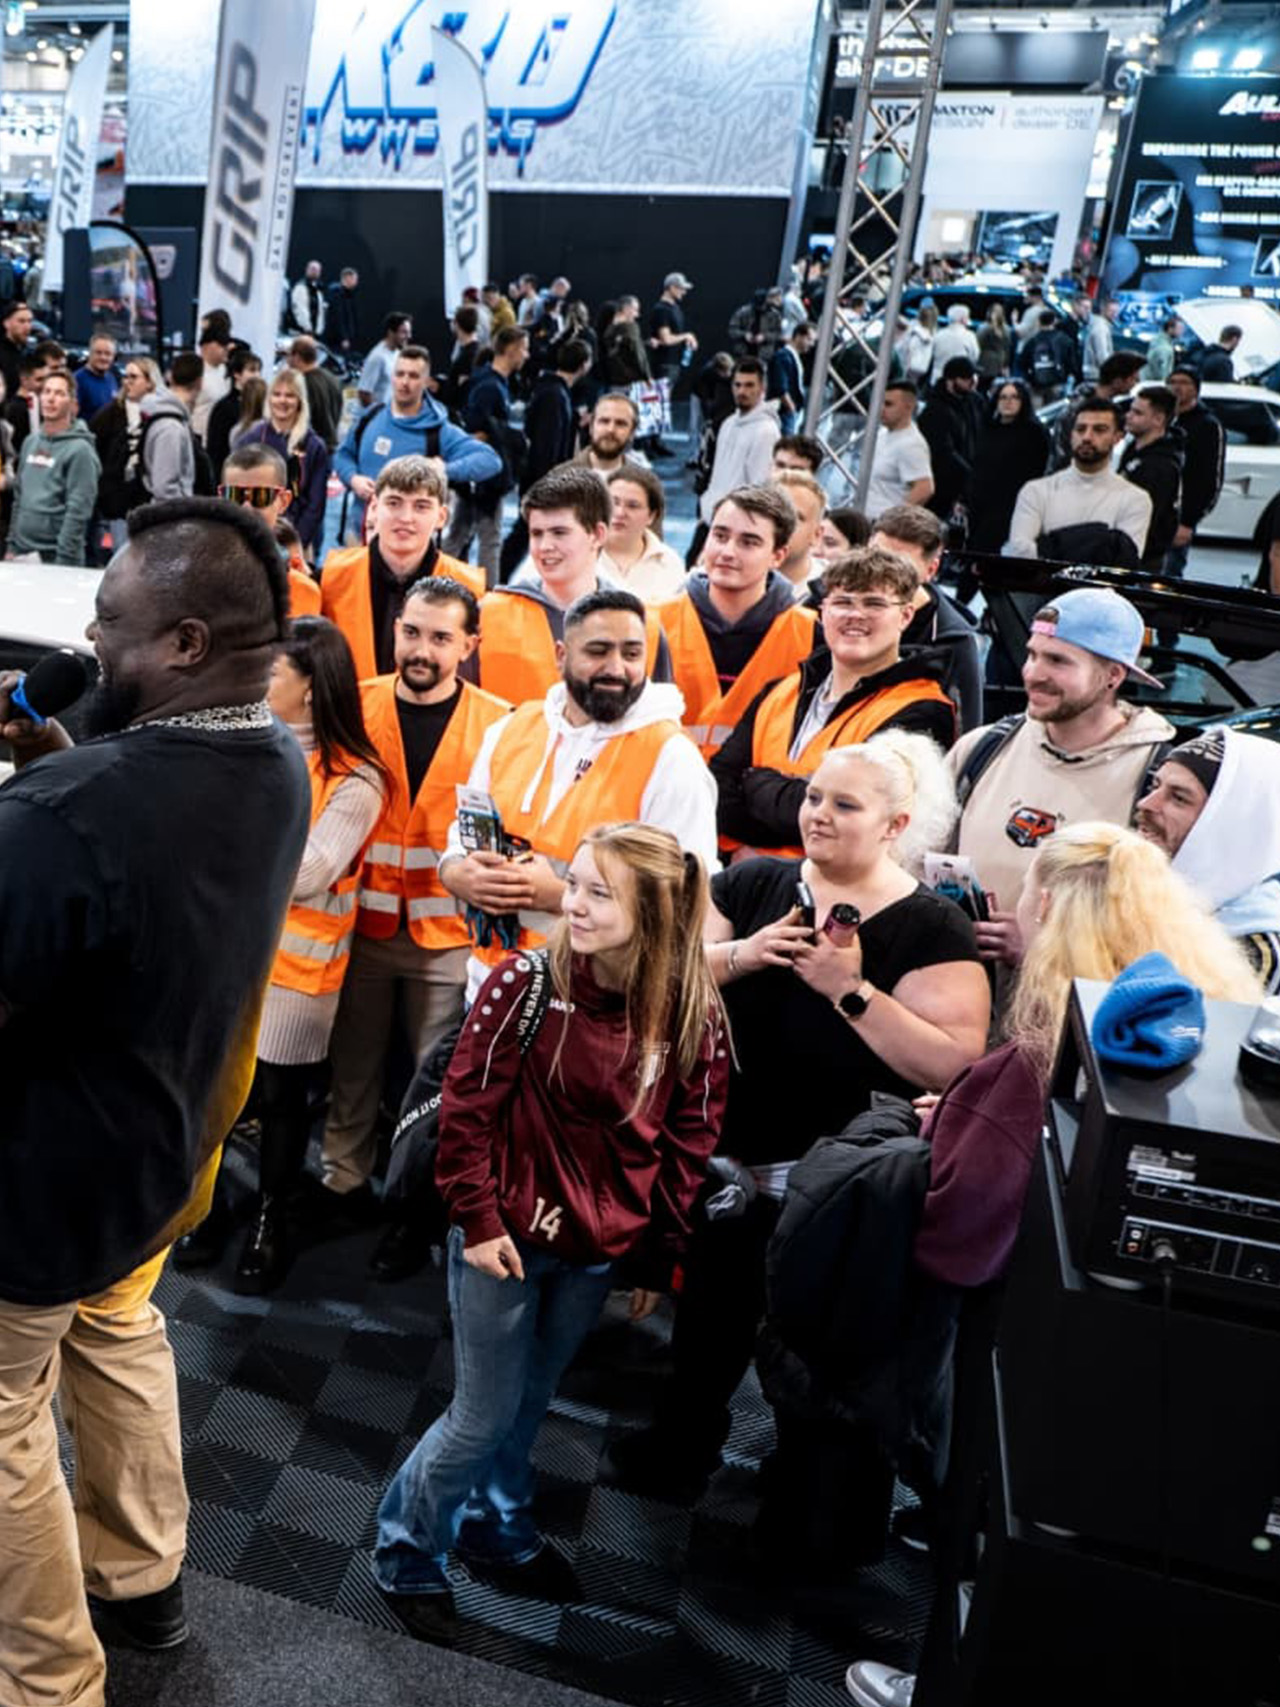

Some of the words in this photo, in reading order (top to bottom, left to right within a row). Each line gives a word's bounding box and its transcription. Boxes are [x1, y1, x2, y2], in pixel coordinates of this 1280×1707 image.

[341, 117, 536, 146] WHES
[210, 39, 268, 306] GRIP
[521, 974, 545, 1018] NEVER
[529, 1196, 563, 1241] 14
